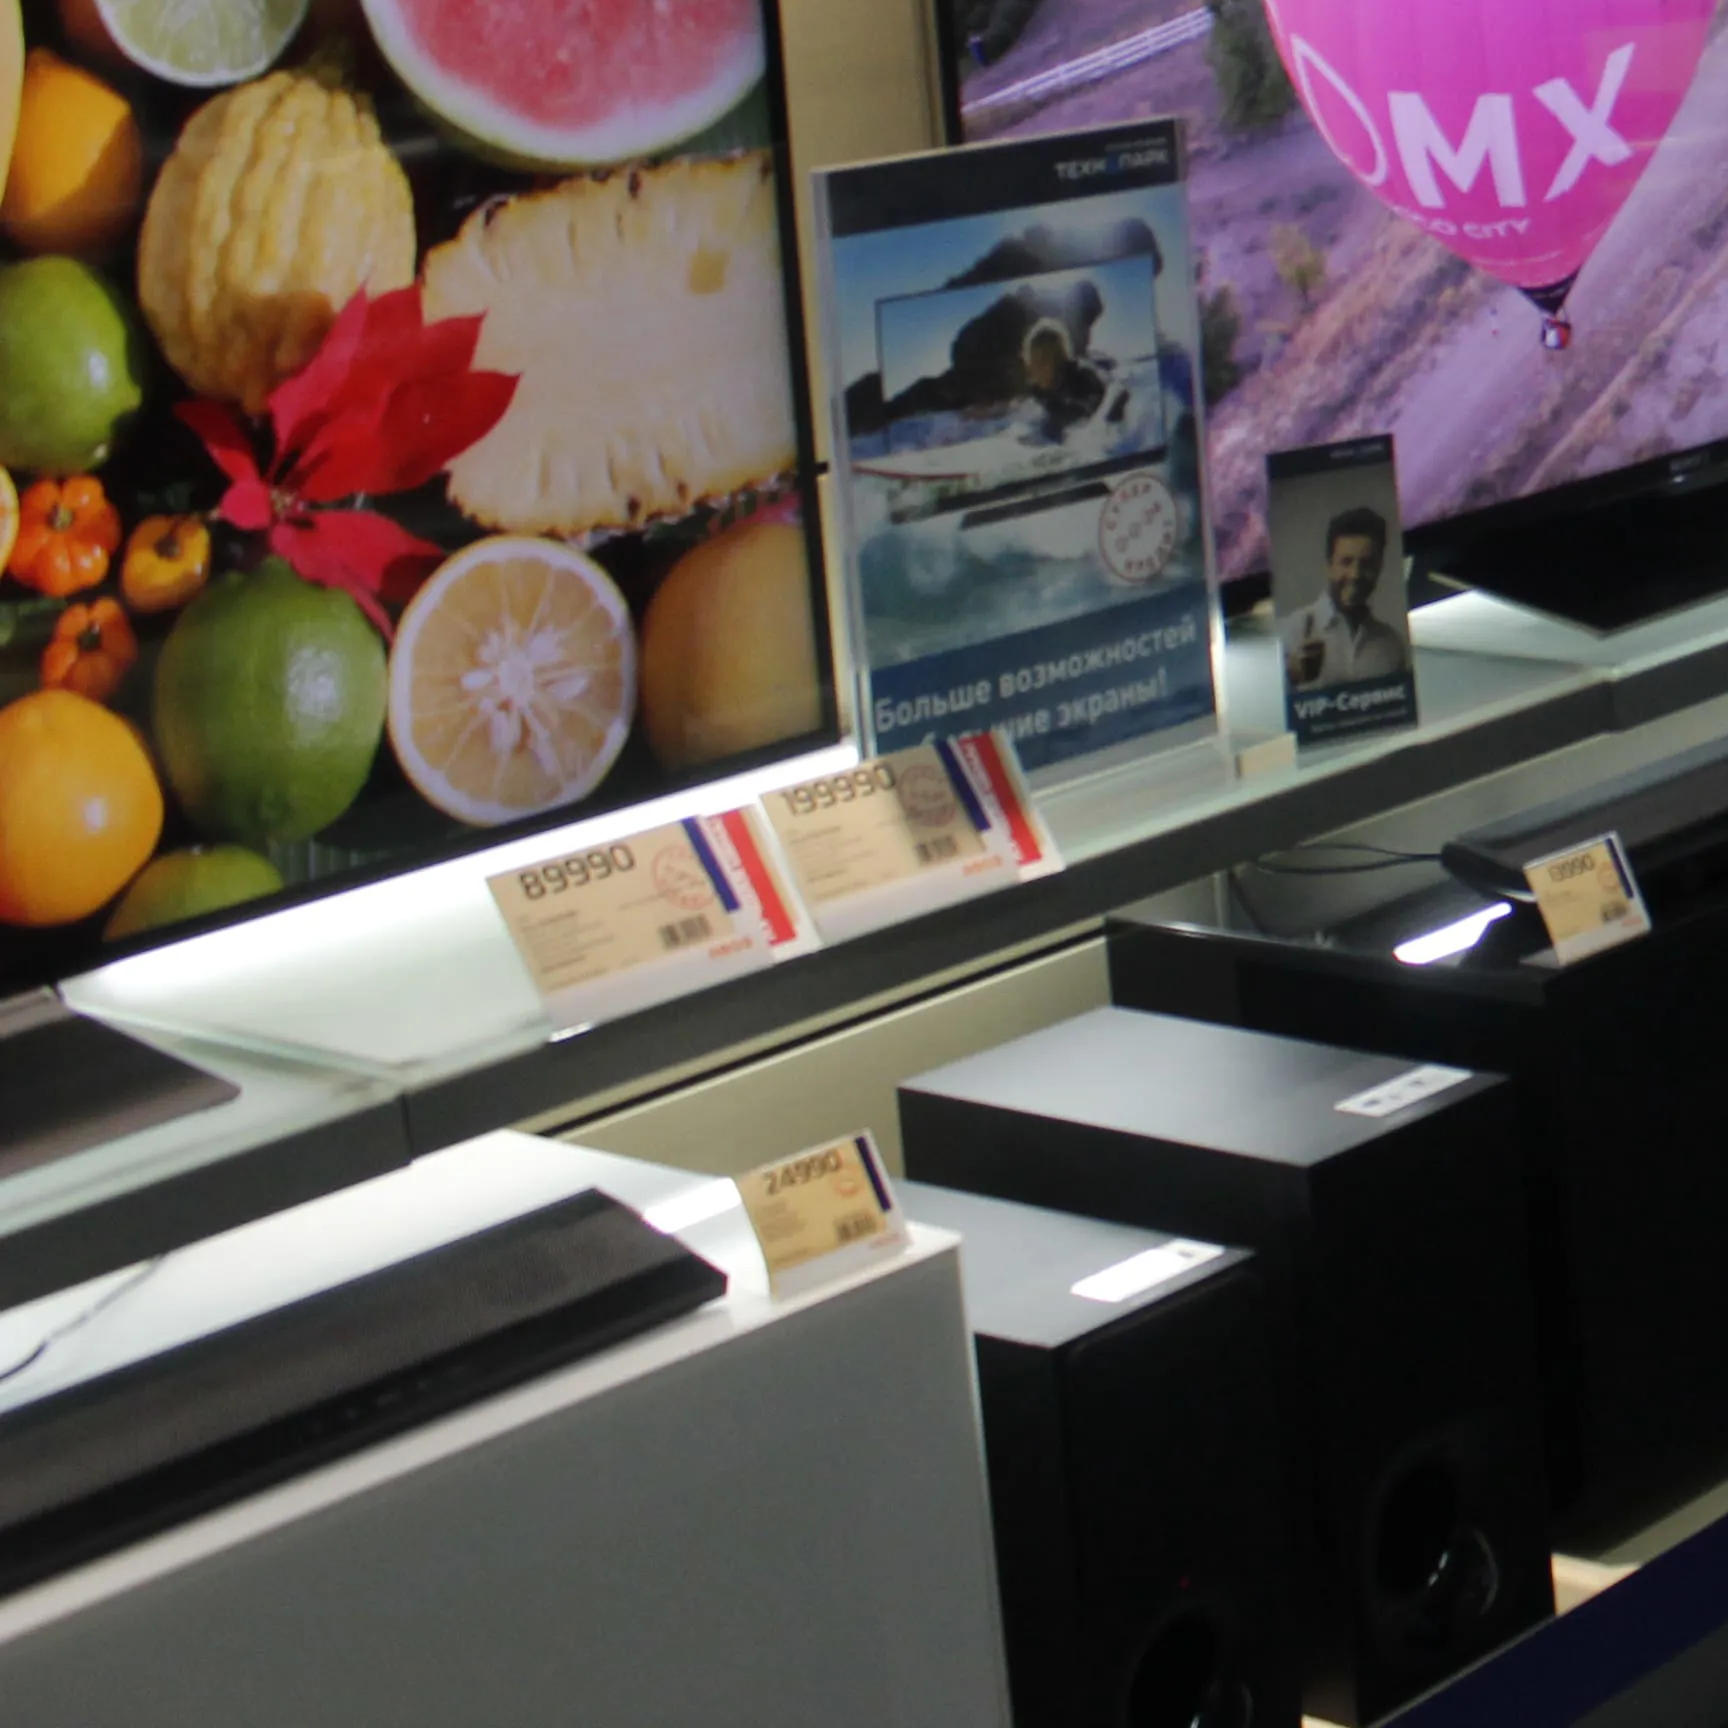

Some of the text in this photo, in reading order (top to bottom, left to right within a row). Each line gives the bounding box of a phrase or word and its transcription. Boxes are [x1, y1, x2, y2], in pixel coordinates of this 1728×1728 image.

[874, 613, 1197, 733] Больше возможностей
[1056, 665, 1168, 726] экраны!
[781, 763, 895, 815] 199990
[518, 841, 636, 901] 89990
